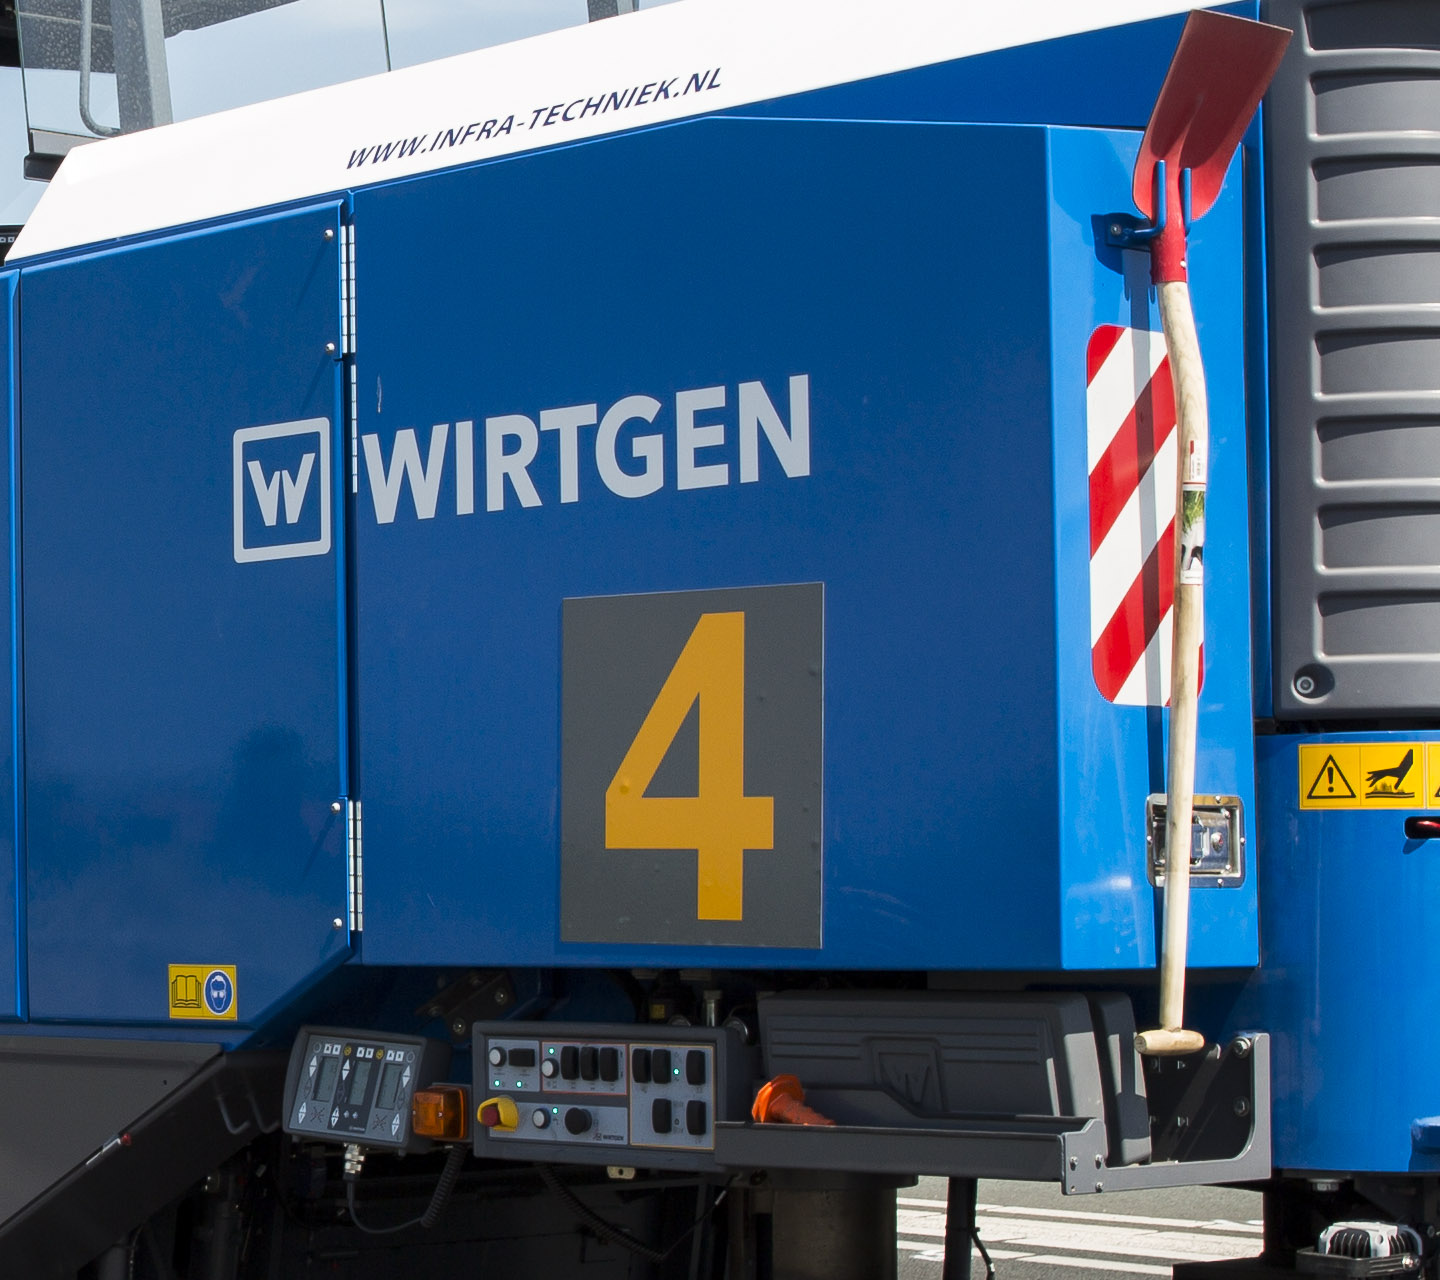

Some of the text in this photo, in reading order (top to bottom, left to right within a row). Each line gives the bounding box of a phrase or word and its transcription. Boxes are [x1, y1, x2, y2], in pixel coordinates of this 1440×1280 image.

[346, 67, 722, 170] WWW.INFRA-TECHNIEK.NL
[361, 373, 811, 525] WIRTGEN
[604, 610, 775, 922] 4
